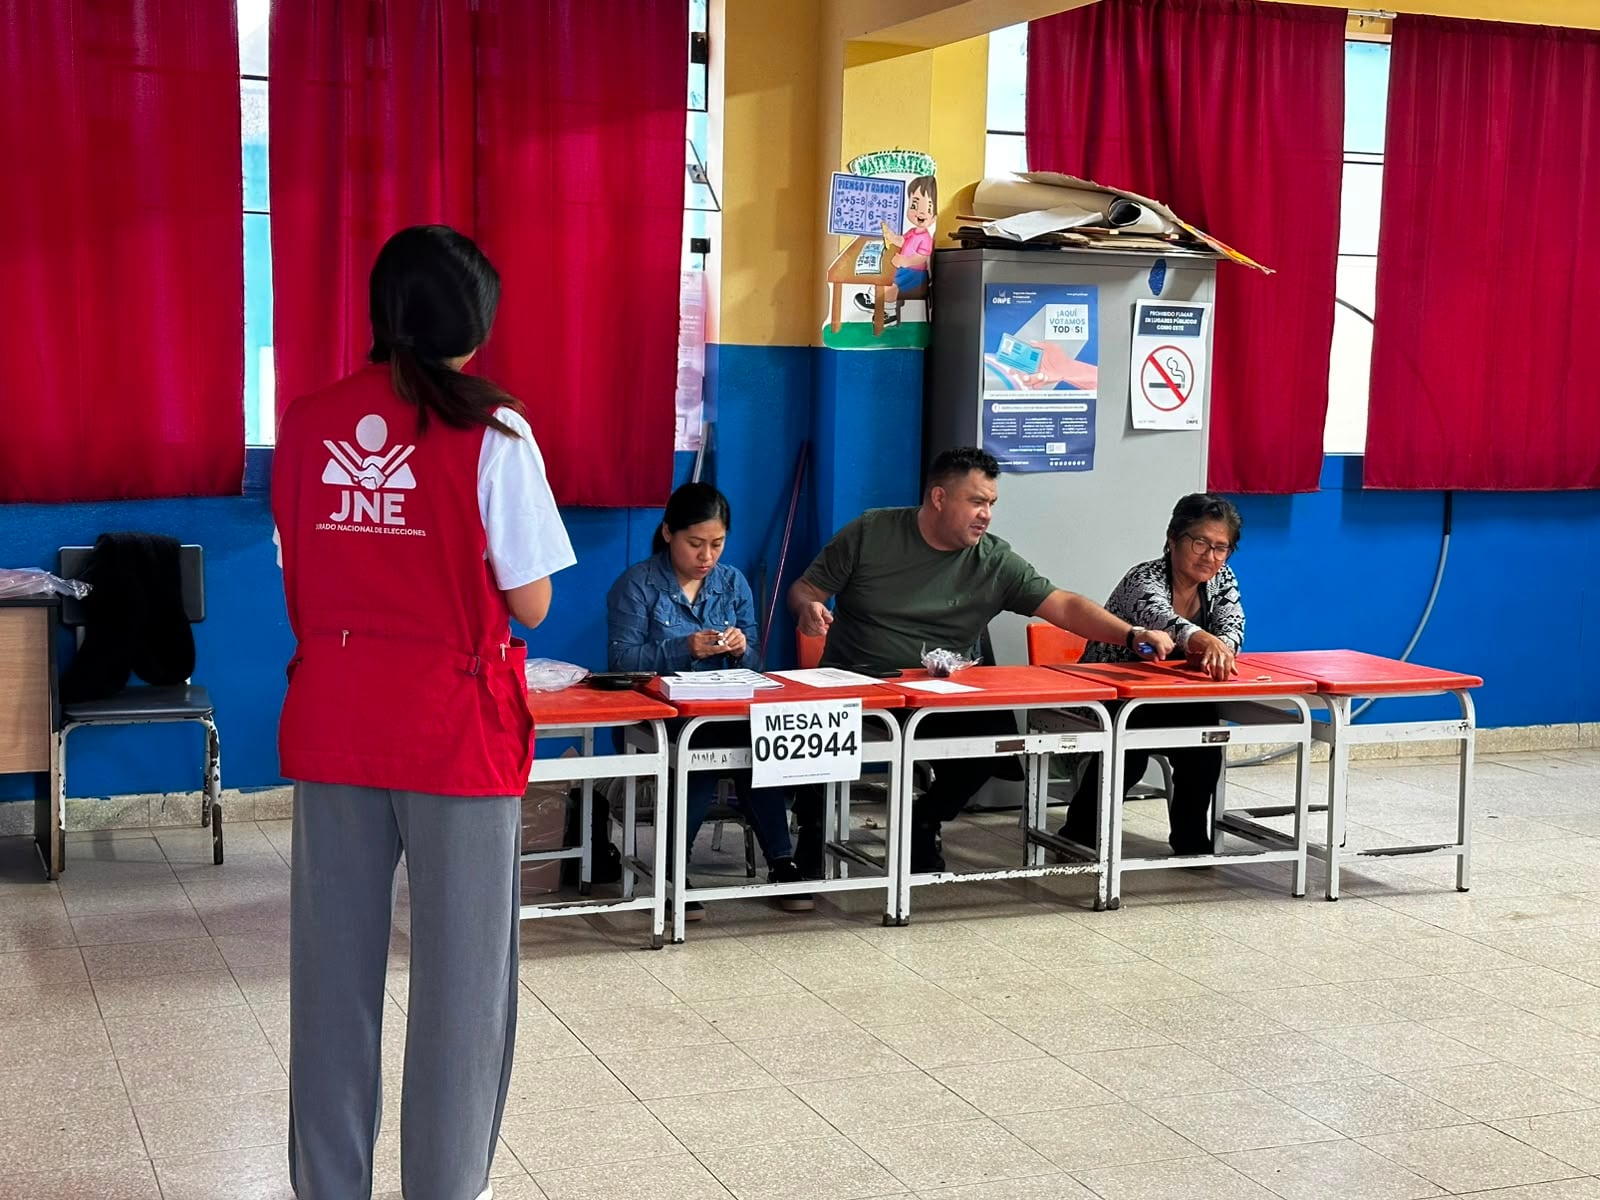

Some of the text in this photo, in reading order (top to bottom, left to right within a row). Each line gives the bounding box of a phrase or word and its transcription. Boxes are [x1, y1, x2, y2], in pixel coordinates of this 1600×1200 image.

[838, 180, 864, 191] PIENSO
[865, 183, 871, 192] Y
[1049, 318, 1086, 326] VOTAMOS
[329, 490, 406, 525] JNE
[336, 525, 374, 534] NACIONAL
[383, 527, 427, 537] ELECCIONES
[765, 713, 823, 732] MESA
[754, 730, 858, 762] 062944
